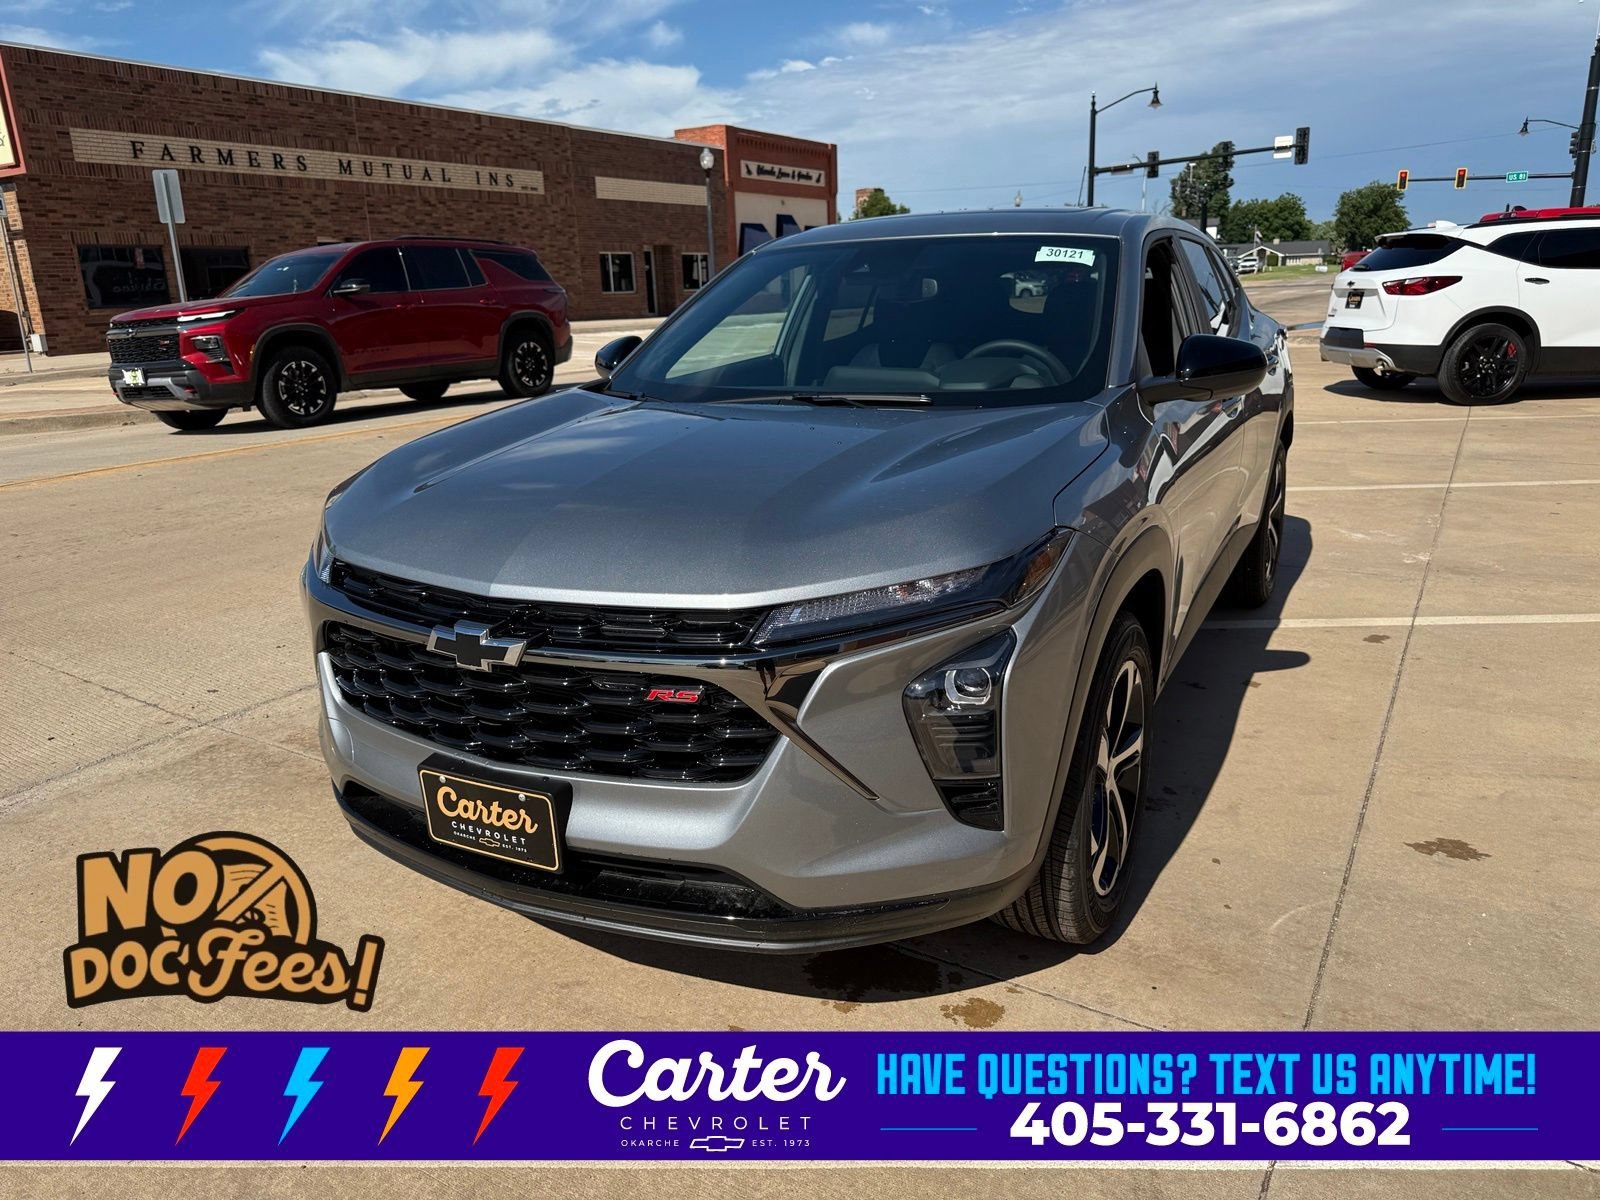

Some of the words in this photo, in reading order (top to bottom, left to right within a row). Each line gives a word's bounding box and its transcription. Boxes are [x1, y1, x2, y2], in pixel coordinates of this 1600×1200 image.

[129, 140, 308, 172] FARMERS
[338, 158, 451, 183] MUTUAL
[475, 171, 514, 188] INS
[1508, 173, 1517, 181] US
[1046, 248, 1084, 259] 30121
[645, 689, 701, 703] RS
[436, 785, 539, 834] Carter
[451, 820, 526, 846] CHEVROLET
